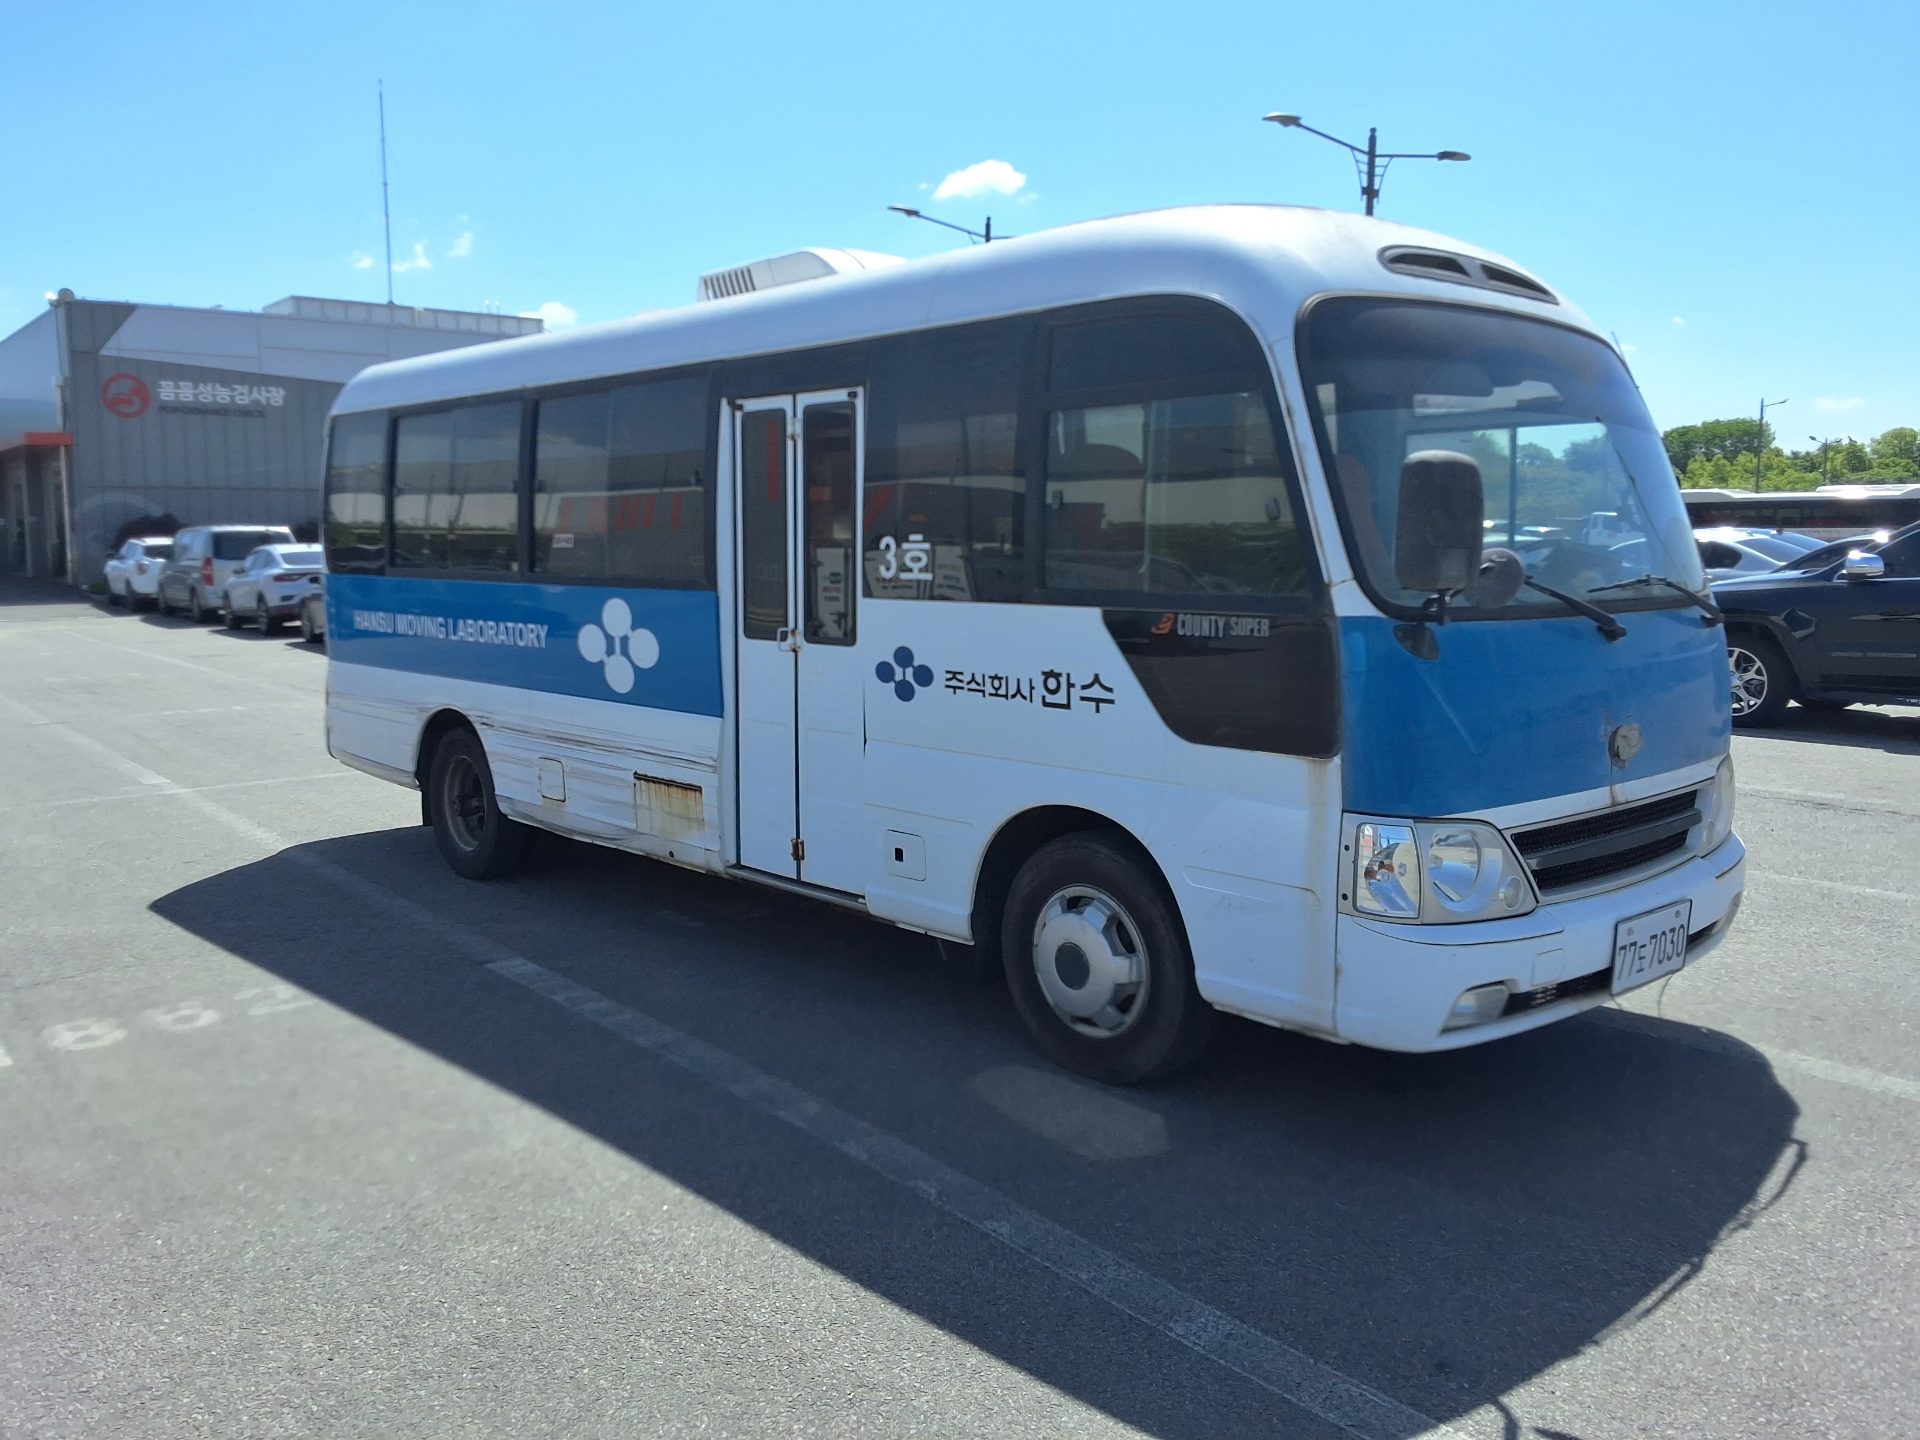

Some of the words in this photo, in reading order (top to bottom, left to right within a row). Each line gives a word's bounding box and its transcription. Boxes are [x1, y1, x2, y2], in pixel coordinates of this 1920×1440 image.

[879, 533, 933, 581] 3호
[353, 610, 394, 634] HANSU
[394, 612, 446, 640] MOVING
[447, 618, 549, 648] LABORATORY
[1177, 614, 1226, 638] COUNTY
[1229, 617, 1270, 637] SUPER
[944, 669, 1035, 703] 주식회사
[1617, 923, 1686, 980] 77도7030
